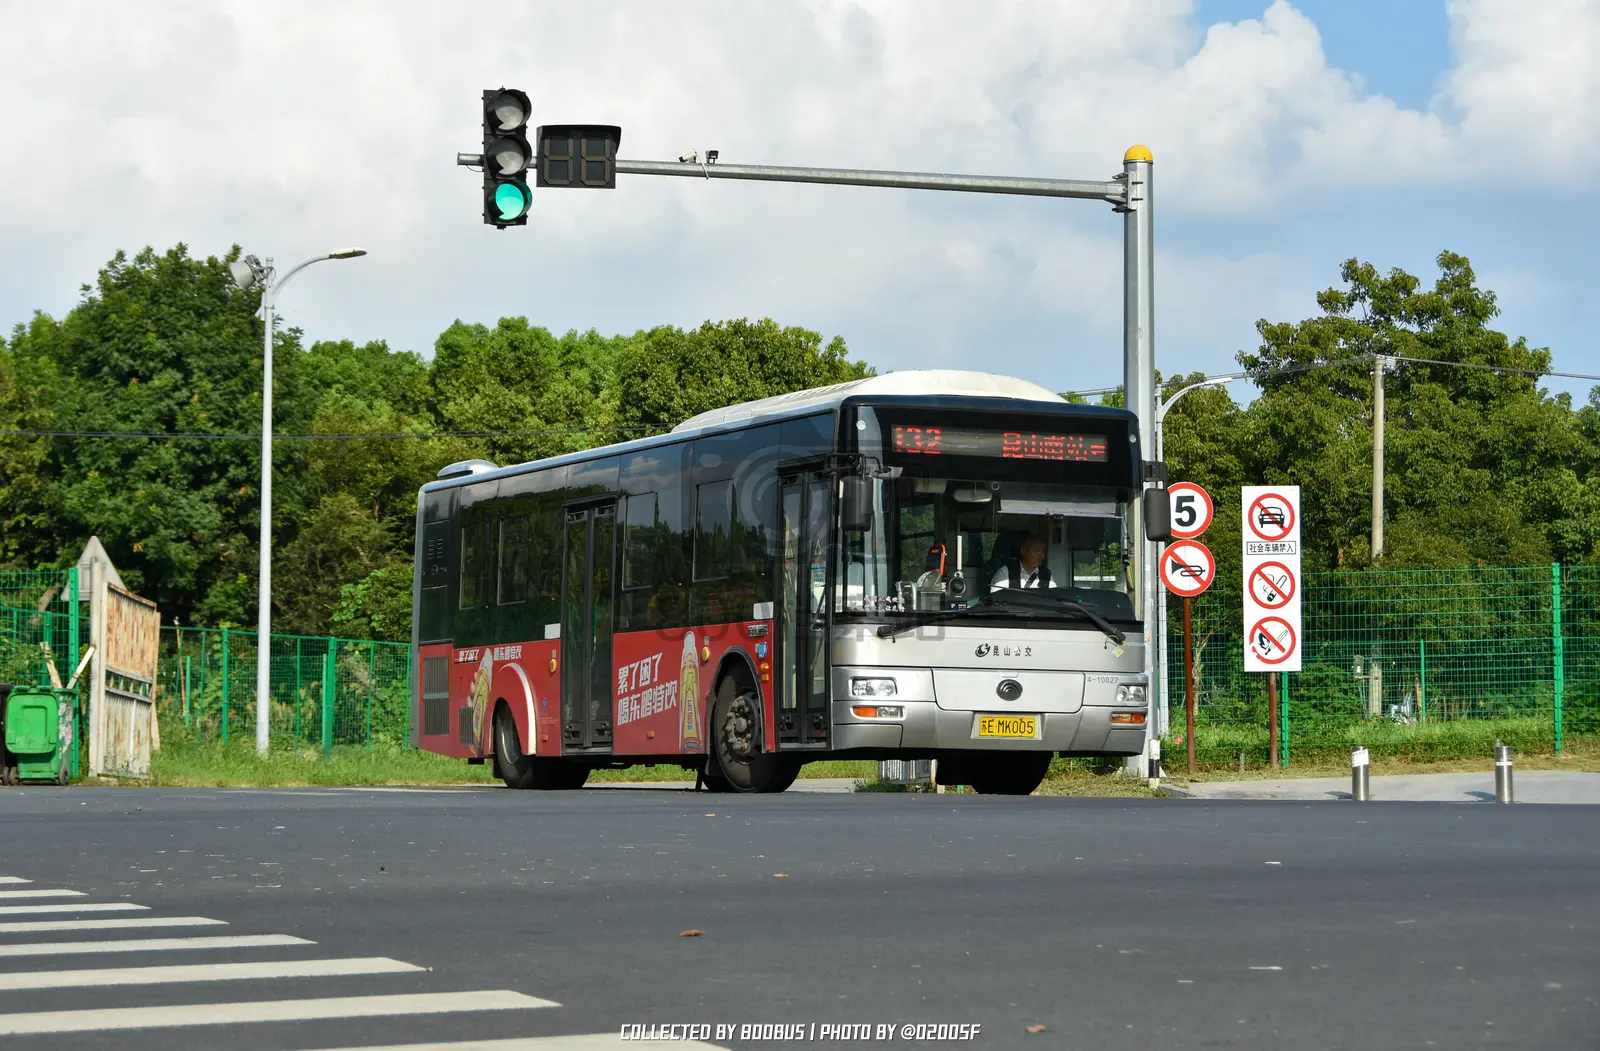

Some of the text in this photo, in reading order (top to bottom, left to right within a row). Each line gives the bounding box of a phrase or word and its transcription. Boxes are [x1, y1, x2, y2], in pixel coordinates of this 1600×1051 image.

[1175, 495, 1197, 527] 5
[1249, 543, 1294, 553] 社会车辆禁入
[993, 645, 1032, 658] 昆山公交
[617, 652, 663, 696] 累了困了
[1087, 676, 1119, 685] 4-10827
[617, 680, 678, 726] 喝东鹏特饮
